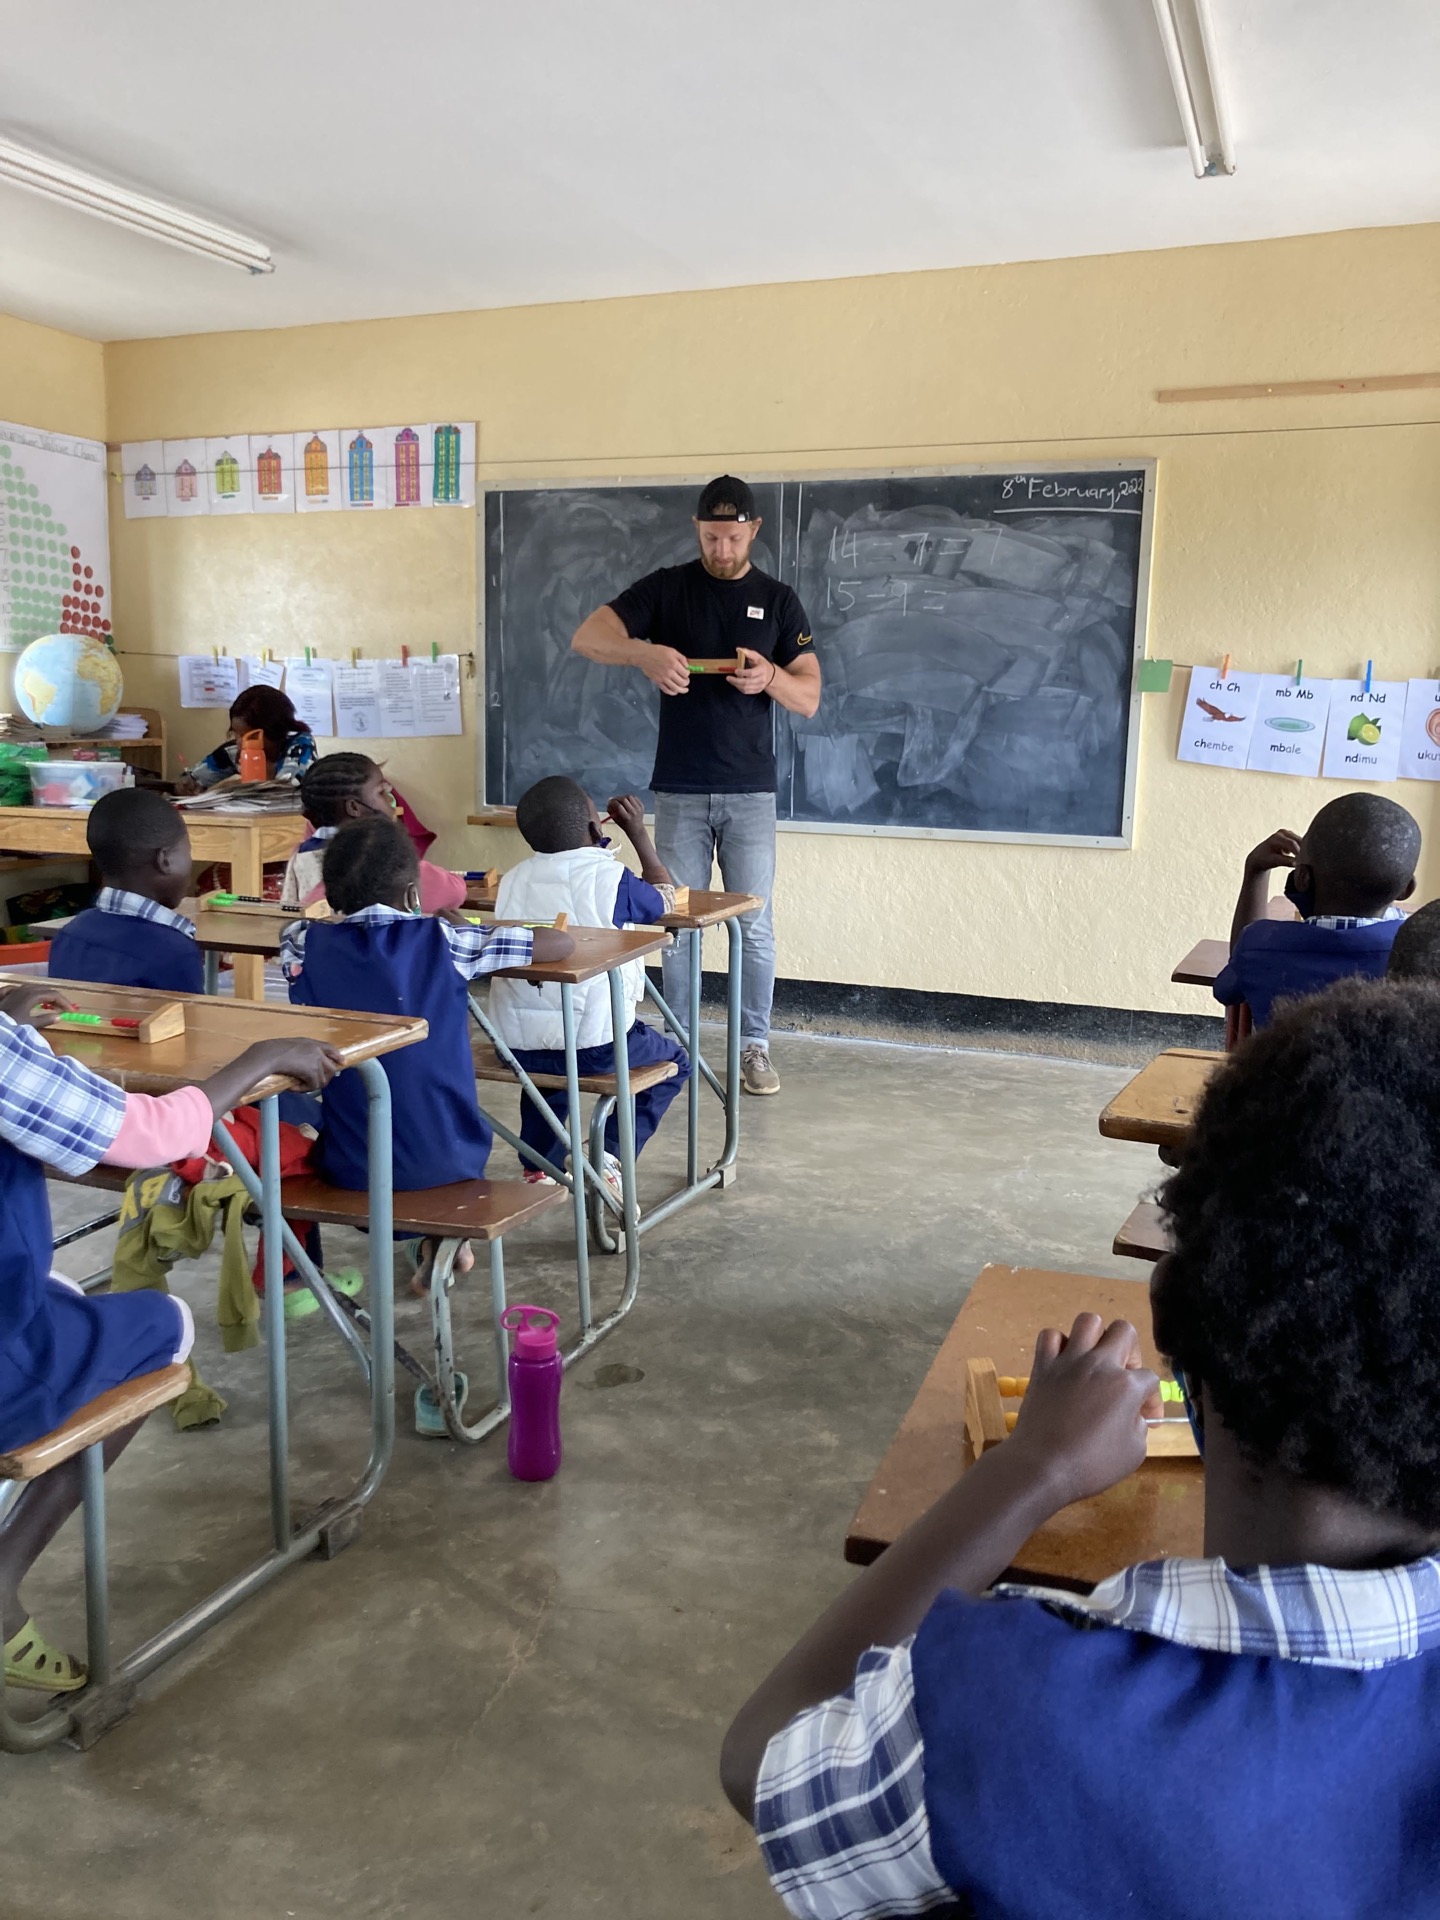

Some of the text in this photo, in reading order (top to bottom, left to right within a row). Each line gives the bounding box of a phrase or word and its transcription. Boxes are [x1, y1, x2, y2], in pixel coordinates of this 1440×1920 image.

[828, 526, 860, 569] 14
[826, 576, 863, 612] 15
[1209, 680, 1241, 693] ch Ch
[1275, 687, 1314, 700] mb Mb
[1350, 692, 1387, 704] nd Nd
[1194, 738, 1234, 753] chembe
[1269, 742, 1302, 755] mbale
[1345, 753, 1378, 765] ndimu
